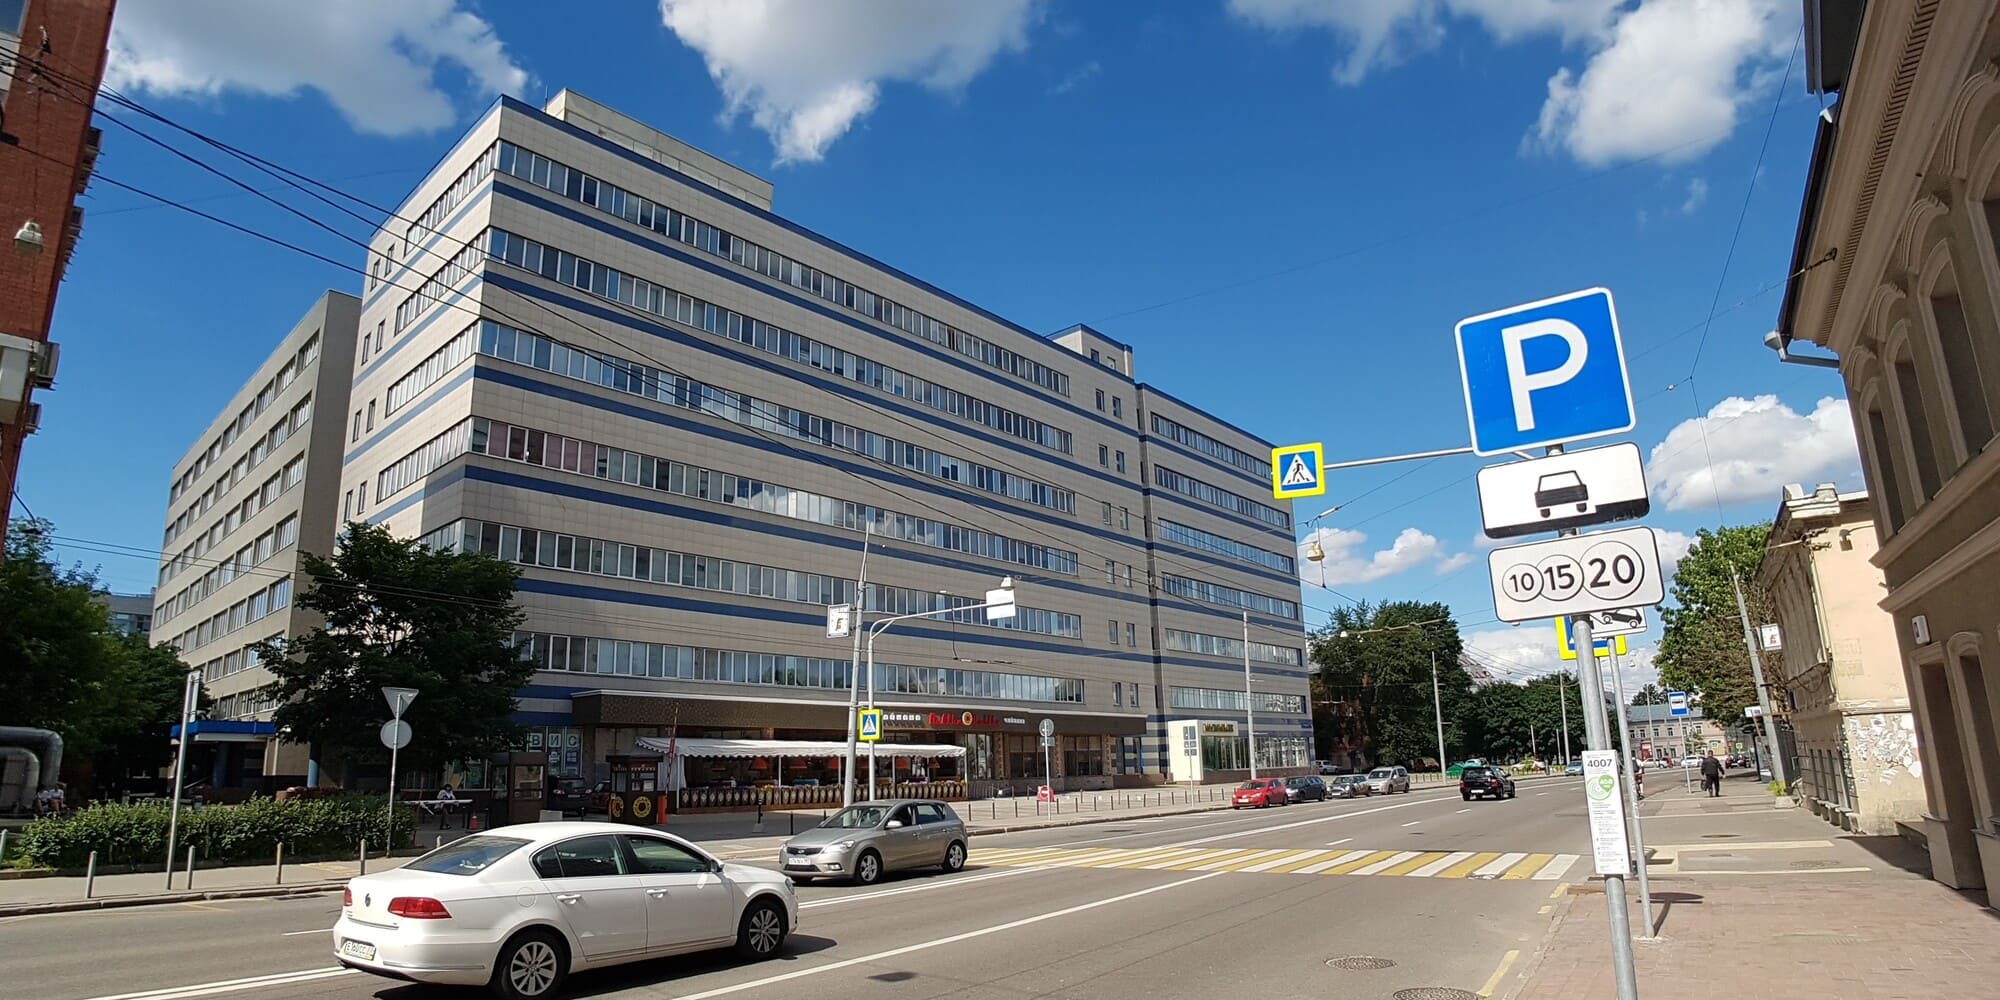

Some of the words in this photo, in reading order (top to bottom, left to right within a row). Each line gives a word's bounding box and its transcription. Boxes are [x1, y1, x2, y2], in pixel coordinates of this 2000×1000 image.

[1501, 318, 1588, 432] P
[1509, 573, 1534, 593] 10
[1543, 564, 1575, 590] 15
[1588, 554, 1635, 589] 20
[1587, 758, 1613, 768] 4007
